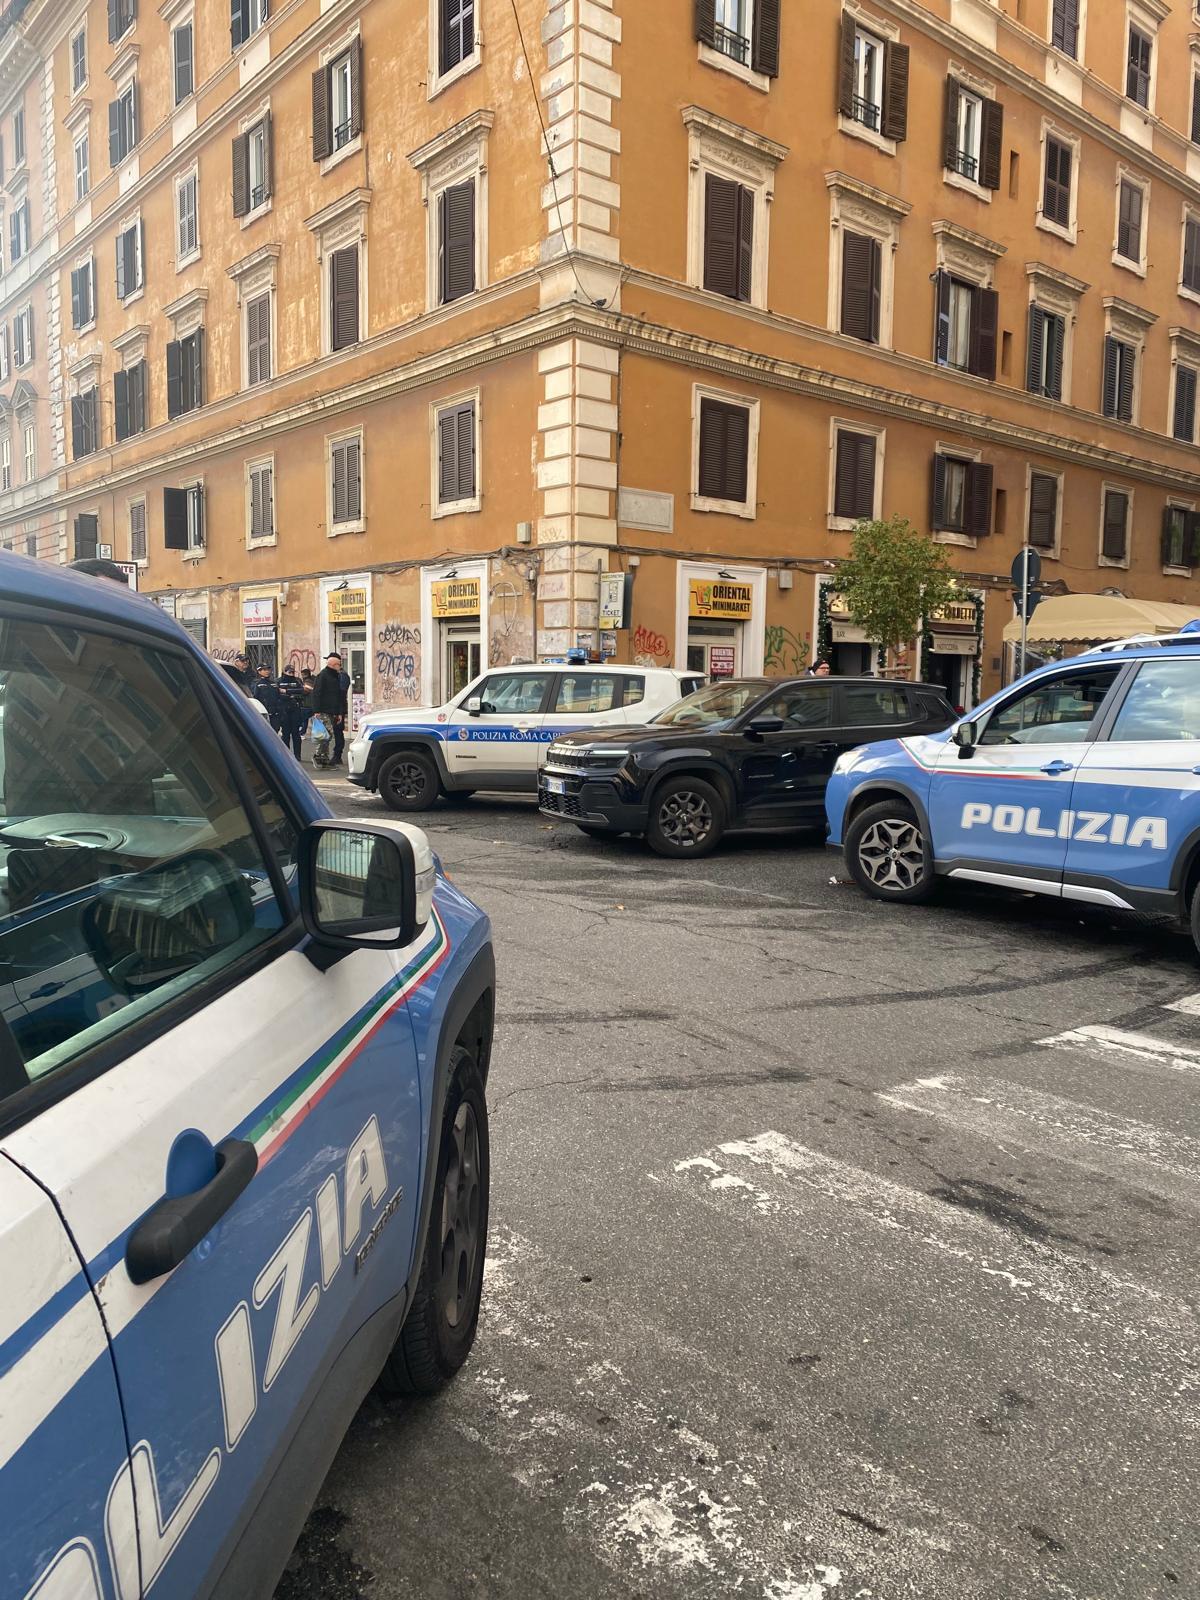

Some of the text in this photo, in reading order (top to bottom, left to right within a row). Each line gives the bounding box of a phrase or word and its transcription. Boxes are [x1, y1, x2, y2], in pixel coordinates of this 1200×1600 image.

[448, 583, 478, 597] ORIENTAL
[713, 585, 751, 600] ORIENTAL
[341, 593, 364, 605] ORIENTAL
[448, 598, 478, 609] MINIMARKET
[712, 601, 751, 612] MINIMARKET
[472, 731, 507, 740] POLIZIA
[510, 732, 537, 740] ROMA
[960, 802, 1168, 850] POLIZIA
